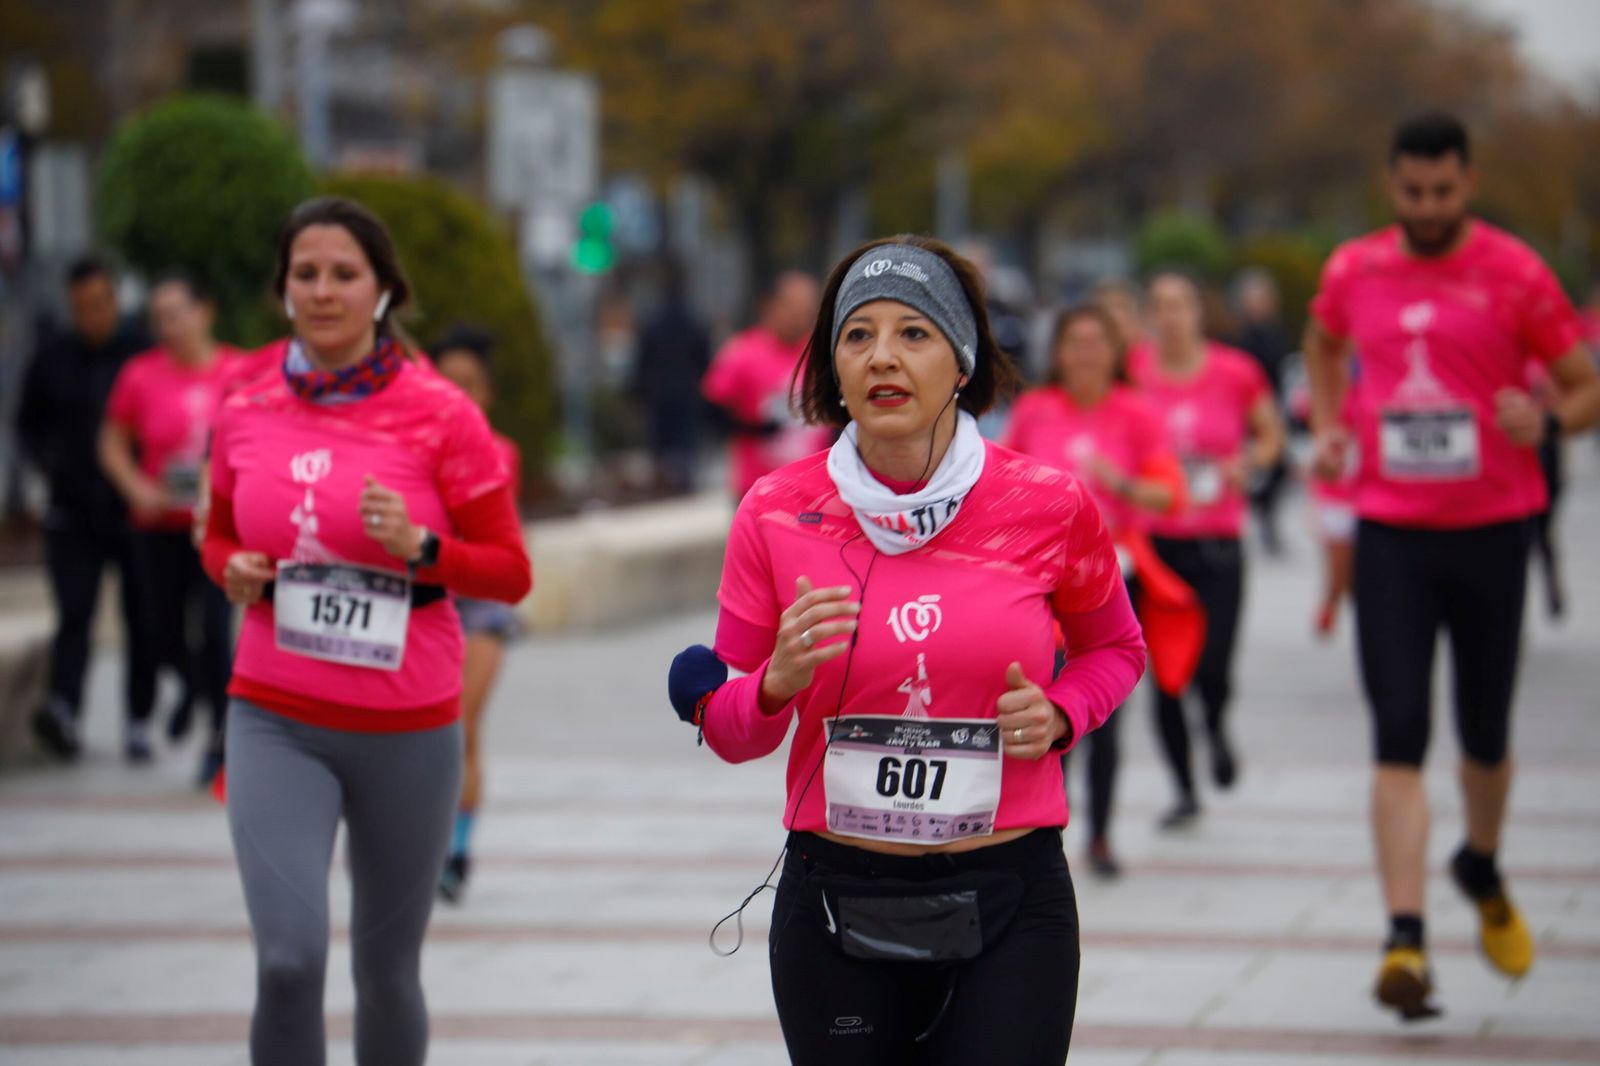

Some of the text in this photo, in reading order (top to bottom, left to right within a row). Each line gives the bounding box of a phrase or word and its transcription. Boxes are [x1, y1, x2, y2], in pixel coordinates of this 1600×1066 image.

[311, 593, 371, 629] 1571
[876, 756, 947, 800] 607
[893, 800, 925, 811] Lourdes
